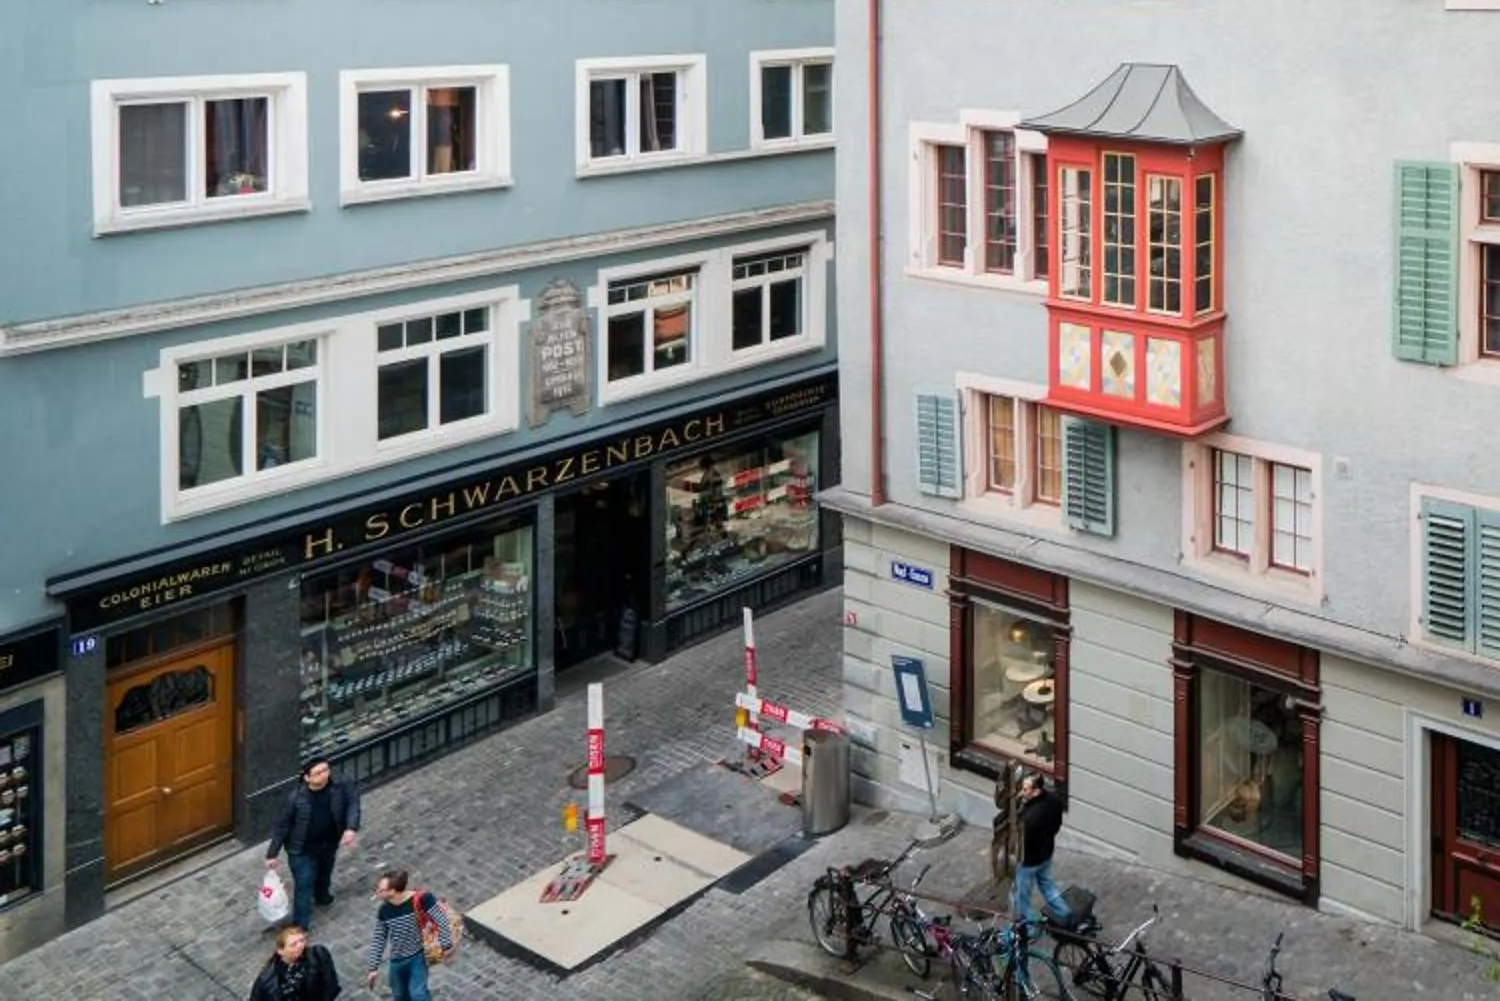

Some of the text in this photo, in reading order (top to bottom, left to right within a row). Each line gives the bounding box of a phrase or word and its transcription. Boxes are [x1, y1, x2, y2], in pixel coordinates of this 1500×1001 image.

[541, 341, 584, 360] POST
[304, 412, 726, 560] H. SCHWARZENBACH
[99, 561, 231, 608] COLONIALWAREN
[140, 584, 193, 609] EIER
[78, 637, 95, 653] 19
